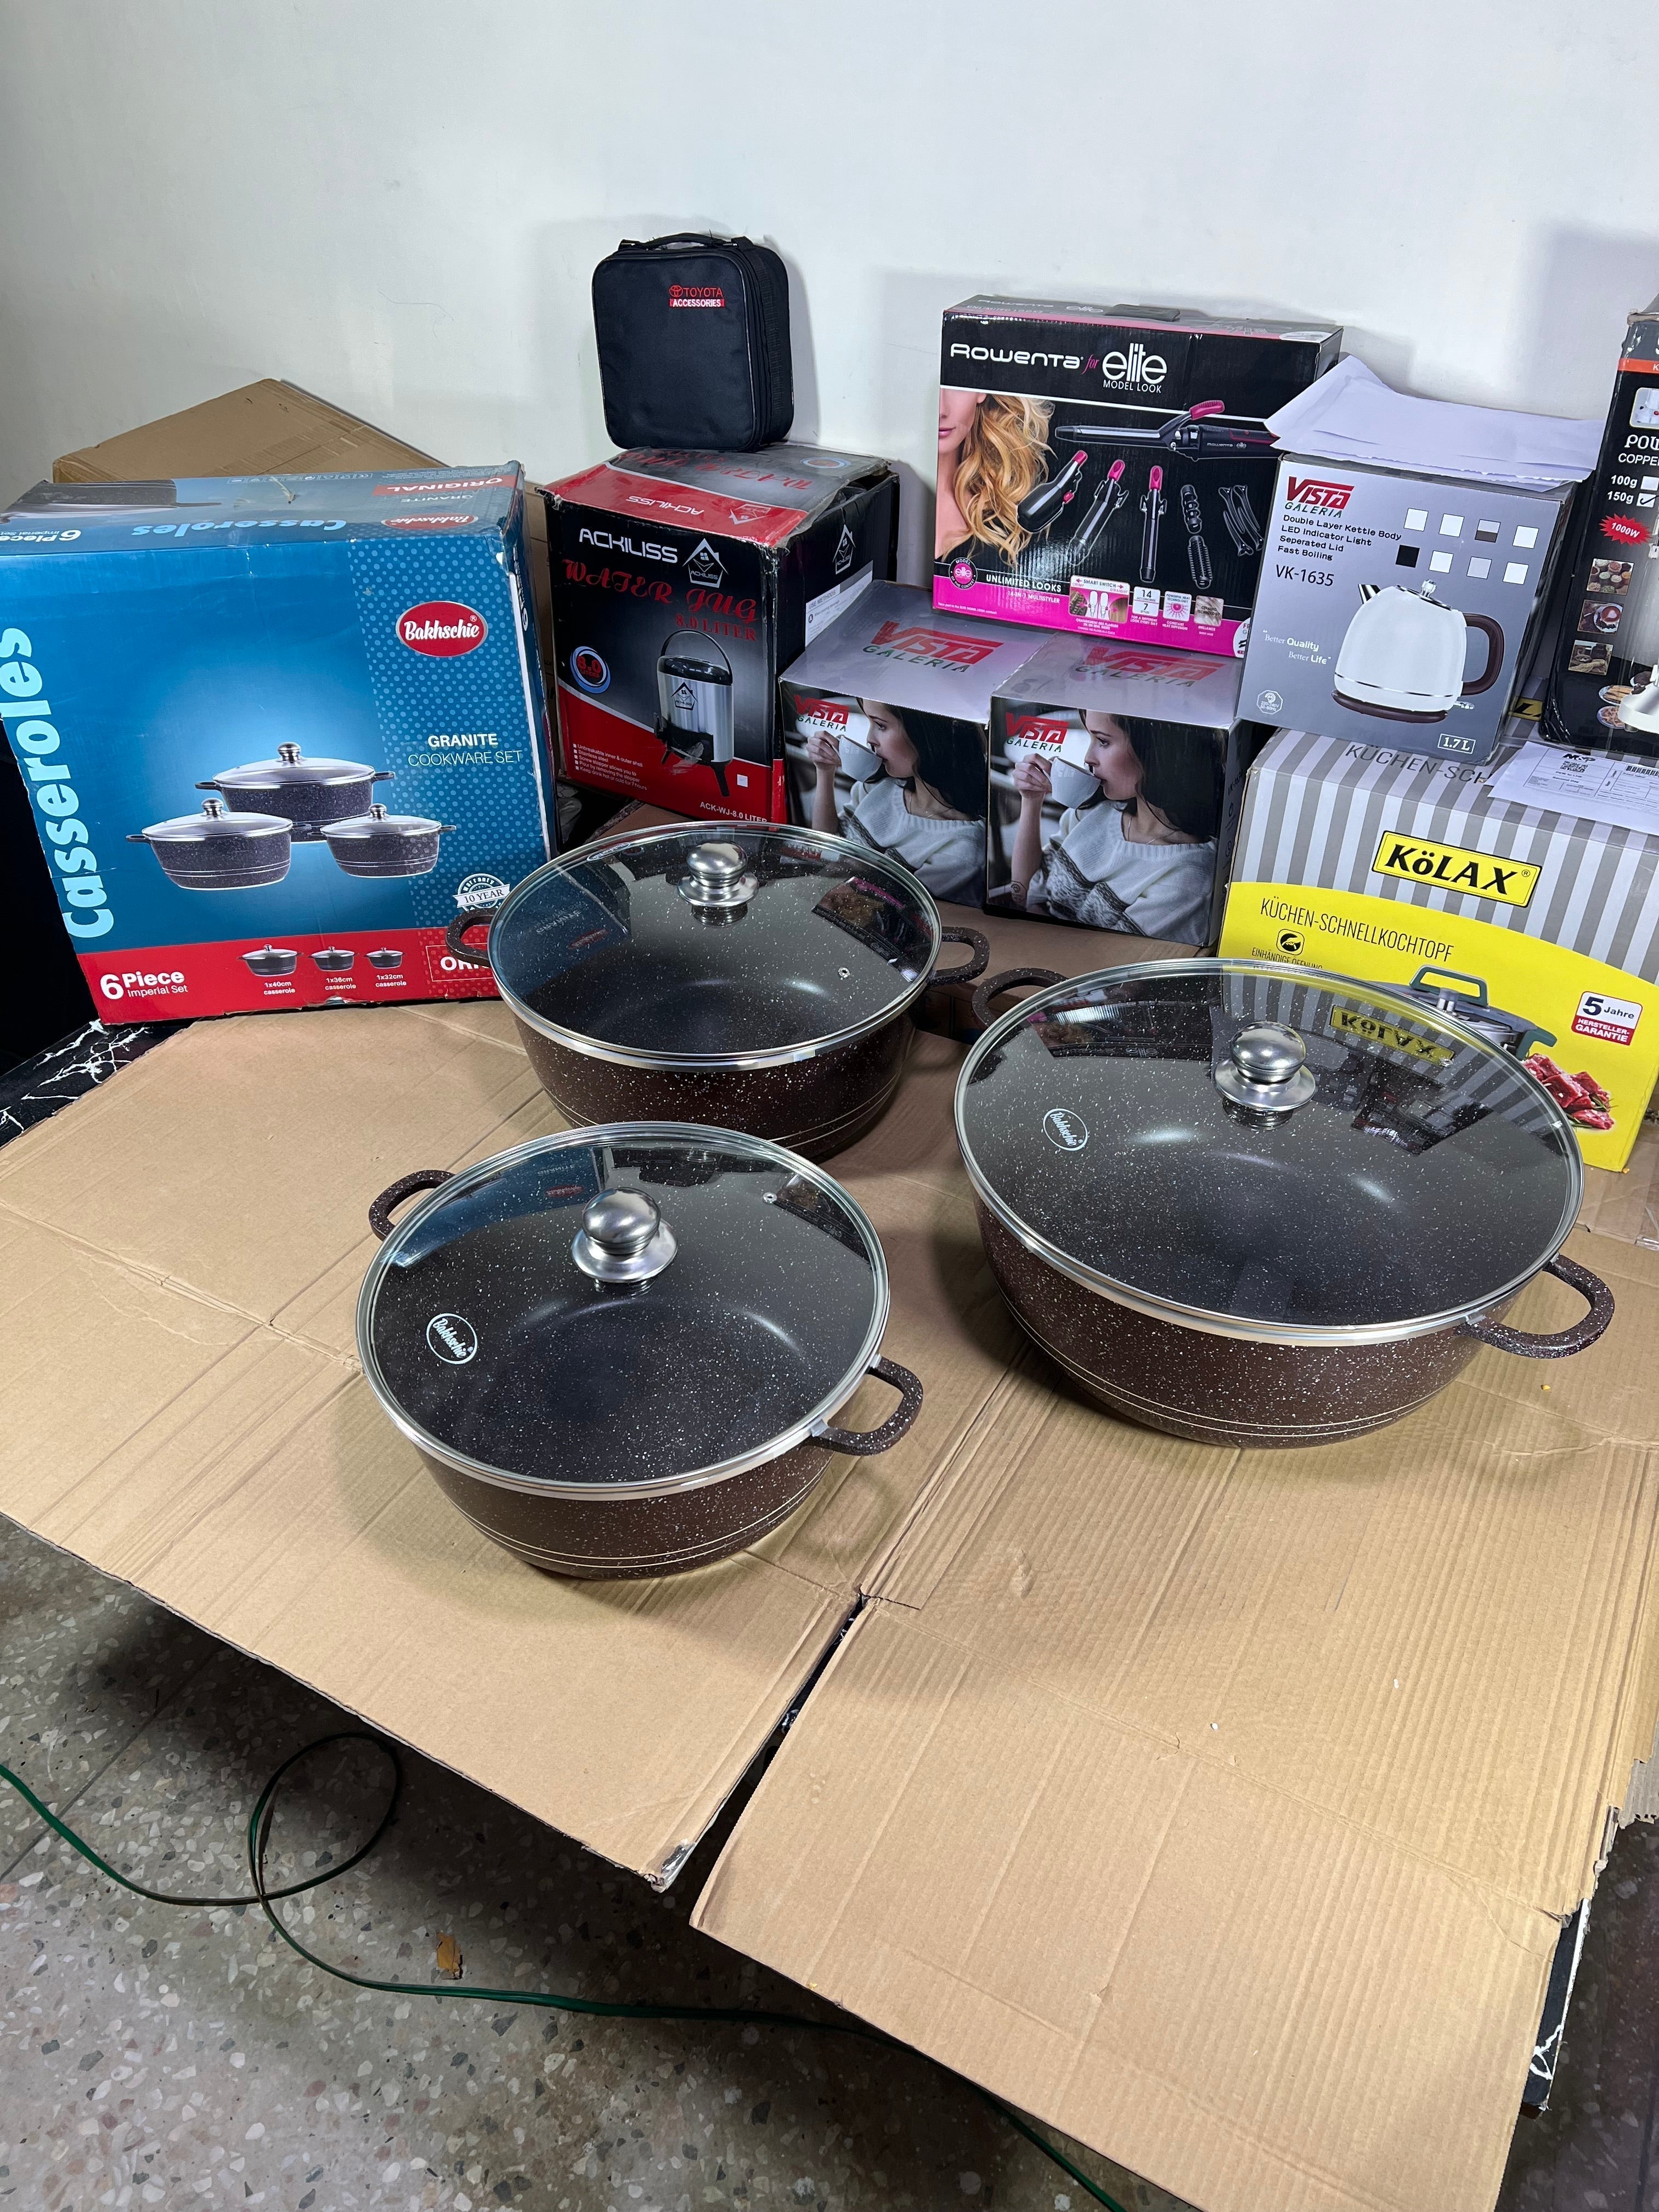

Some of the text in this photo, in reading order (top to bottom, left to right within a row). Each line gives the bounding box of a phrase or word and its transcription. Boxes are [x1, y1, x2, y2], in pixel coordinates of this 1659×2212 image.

[683, 287, 723, 297] TOYOTA
[673, 298, 721, 307] ACCESSORIES
[1080, 354, 1099, 375] for
[1102, 343, 1167, 384] elite
[1103, 379, 1162, 394] MODEL LOOK
[387, 477, 503, 492] ORIGINAL
[1611, 475, 1638, 488] 100g
[1288, 476, 1355, 510] VISTA
[1607, 491, 1633, 505] 150g
[626, 495, 704, 516] ACKILISS
[1284, 501, 1342, 518] GALERIA
[59, 529, 81, 541] 6
[131, 520, 347, 537] Casseroles
[1282, 525, 1372, 547] LED Indicator Light
[1283, 515, 1402, 541] Double Layer Kettle Body
[1611, 522, 1640, 538] 1000W
[579, 528, 678, 563] ACKILISS
[1279, 535, 1344, 552] Seperated Lid
[1278, 545, 1333, 561] Fast Boiling
[986, 574, 1062, 592] UNLIMITED LOOKS
[1276, 564, 1334, 587] VK-1635
[562, 558, 673, 603] WATER
[686, 589, 759, 624] JUG
[1028, 594, 1060, 603] MULTISTYLER
[1142, 589, 1152, 598] 14
[404, 620, 480, 640] Bakhschie
[702, 618, 757, 642] LITER
[871, 620, 1005, 664] VISTA
[1286, 637, 1319, 652] Quality
[577, 656, 602, 674] 8.0
[862, 645, 971, 673] GALERIA
[1084, 647, 1226, 681] VISTA
[1288, 652, 1310, 662] Better
[1075, 666, 1197, 687] GALERIA
[793, 694, 850, 725] VISTA
[797, 715, 847, 732] GALERIA
[1006, 712, 1070, 744] VISTA
[427, 733, 498, 747] GRANITE
[1006, 737, 1062, 752] GALERIA
[408, 750, 522, 766] COOKWARE SET
[1563, 753, 1596, 763] M&P
[700, 802, 743, 819] ACK-WJ-8.0
[464, 889, 505, 904] 10 YEAR
[1261, 895, 1454, 962] KÜCHEN-SCHNELLKOCHTOPF
[100, 971, 184, 1000] 6 Piece
[127, 985, 188, 998] Imperial Set
[1582, 996, 1634, 1019] 5 Jahre
[1575, 1024, 1628, 1042] GARANTIE
[1577, 1018, 1630, 1035] HERSTELLER-
[432, 1318, 467, 1358] Bakhschie
